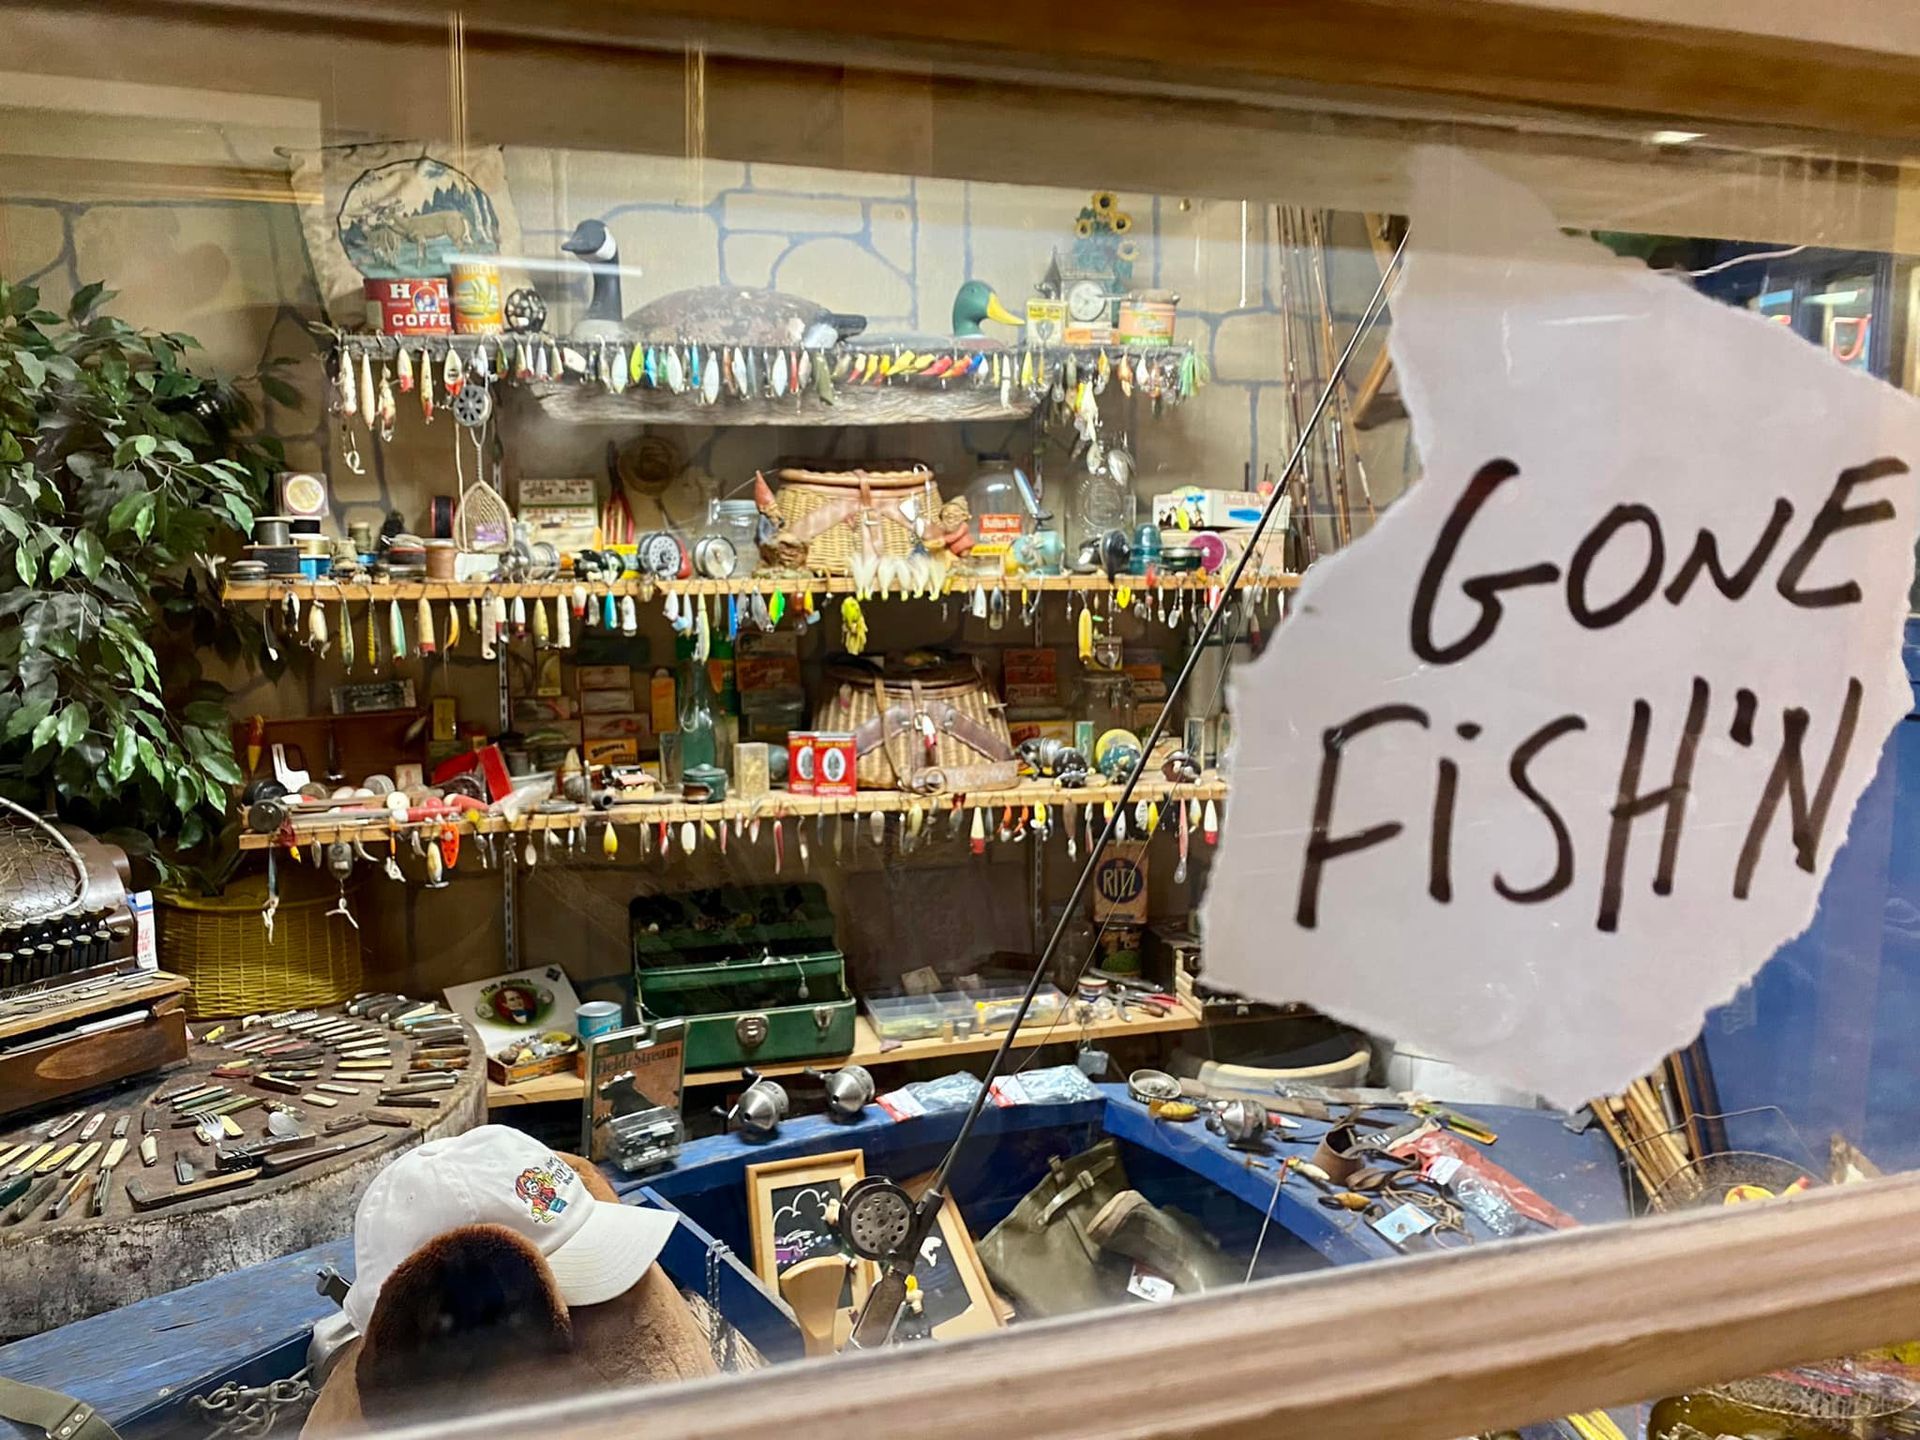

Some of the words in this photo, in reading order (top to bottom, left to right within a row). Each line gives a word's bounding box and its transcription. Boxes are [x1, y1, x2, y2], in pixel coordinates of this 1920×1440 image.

[1411, 457, 1909, 665] GONE
[1103, 868, 1137, 897] RITZ
[595, 1053, 627, 1075] Field
[633, 1047, 679, 1068] Stream
